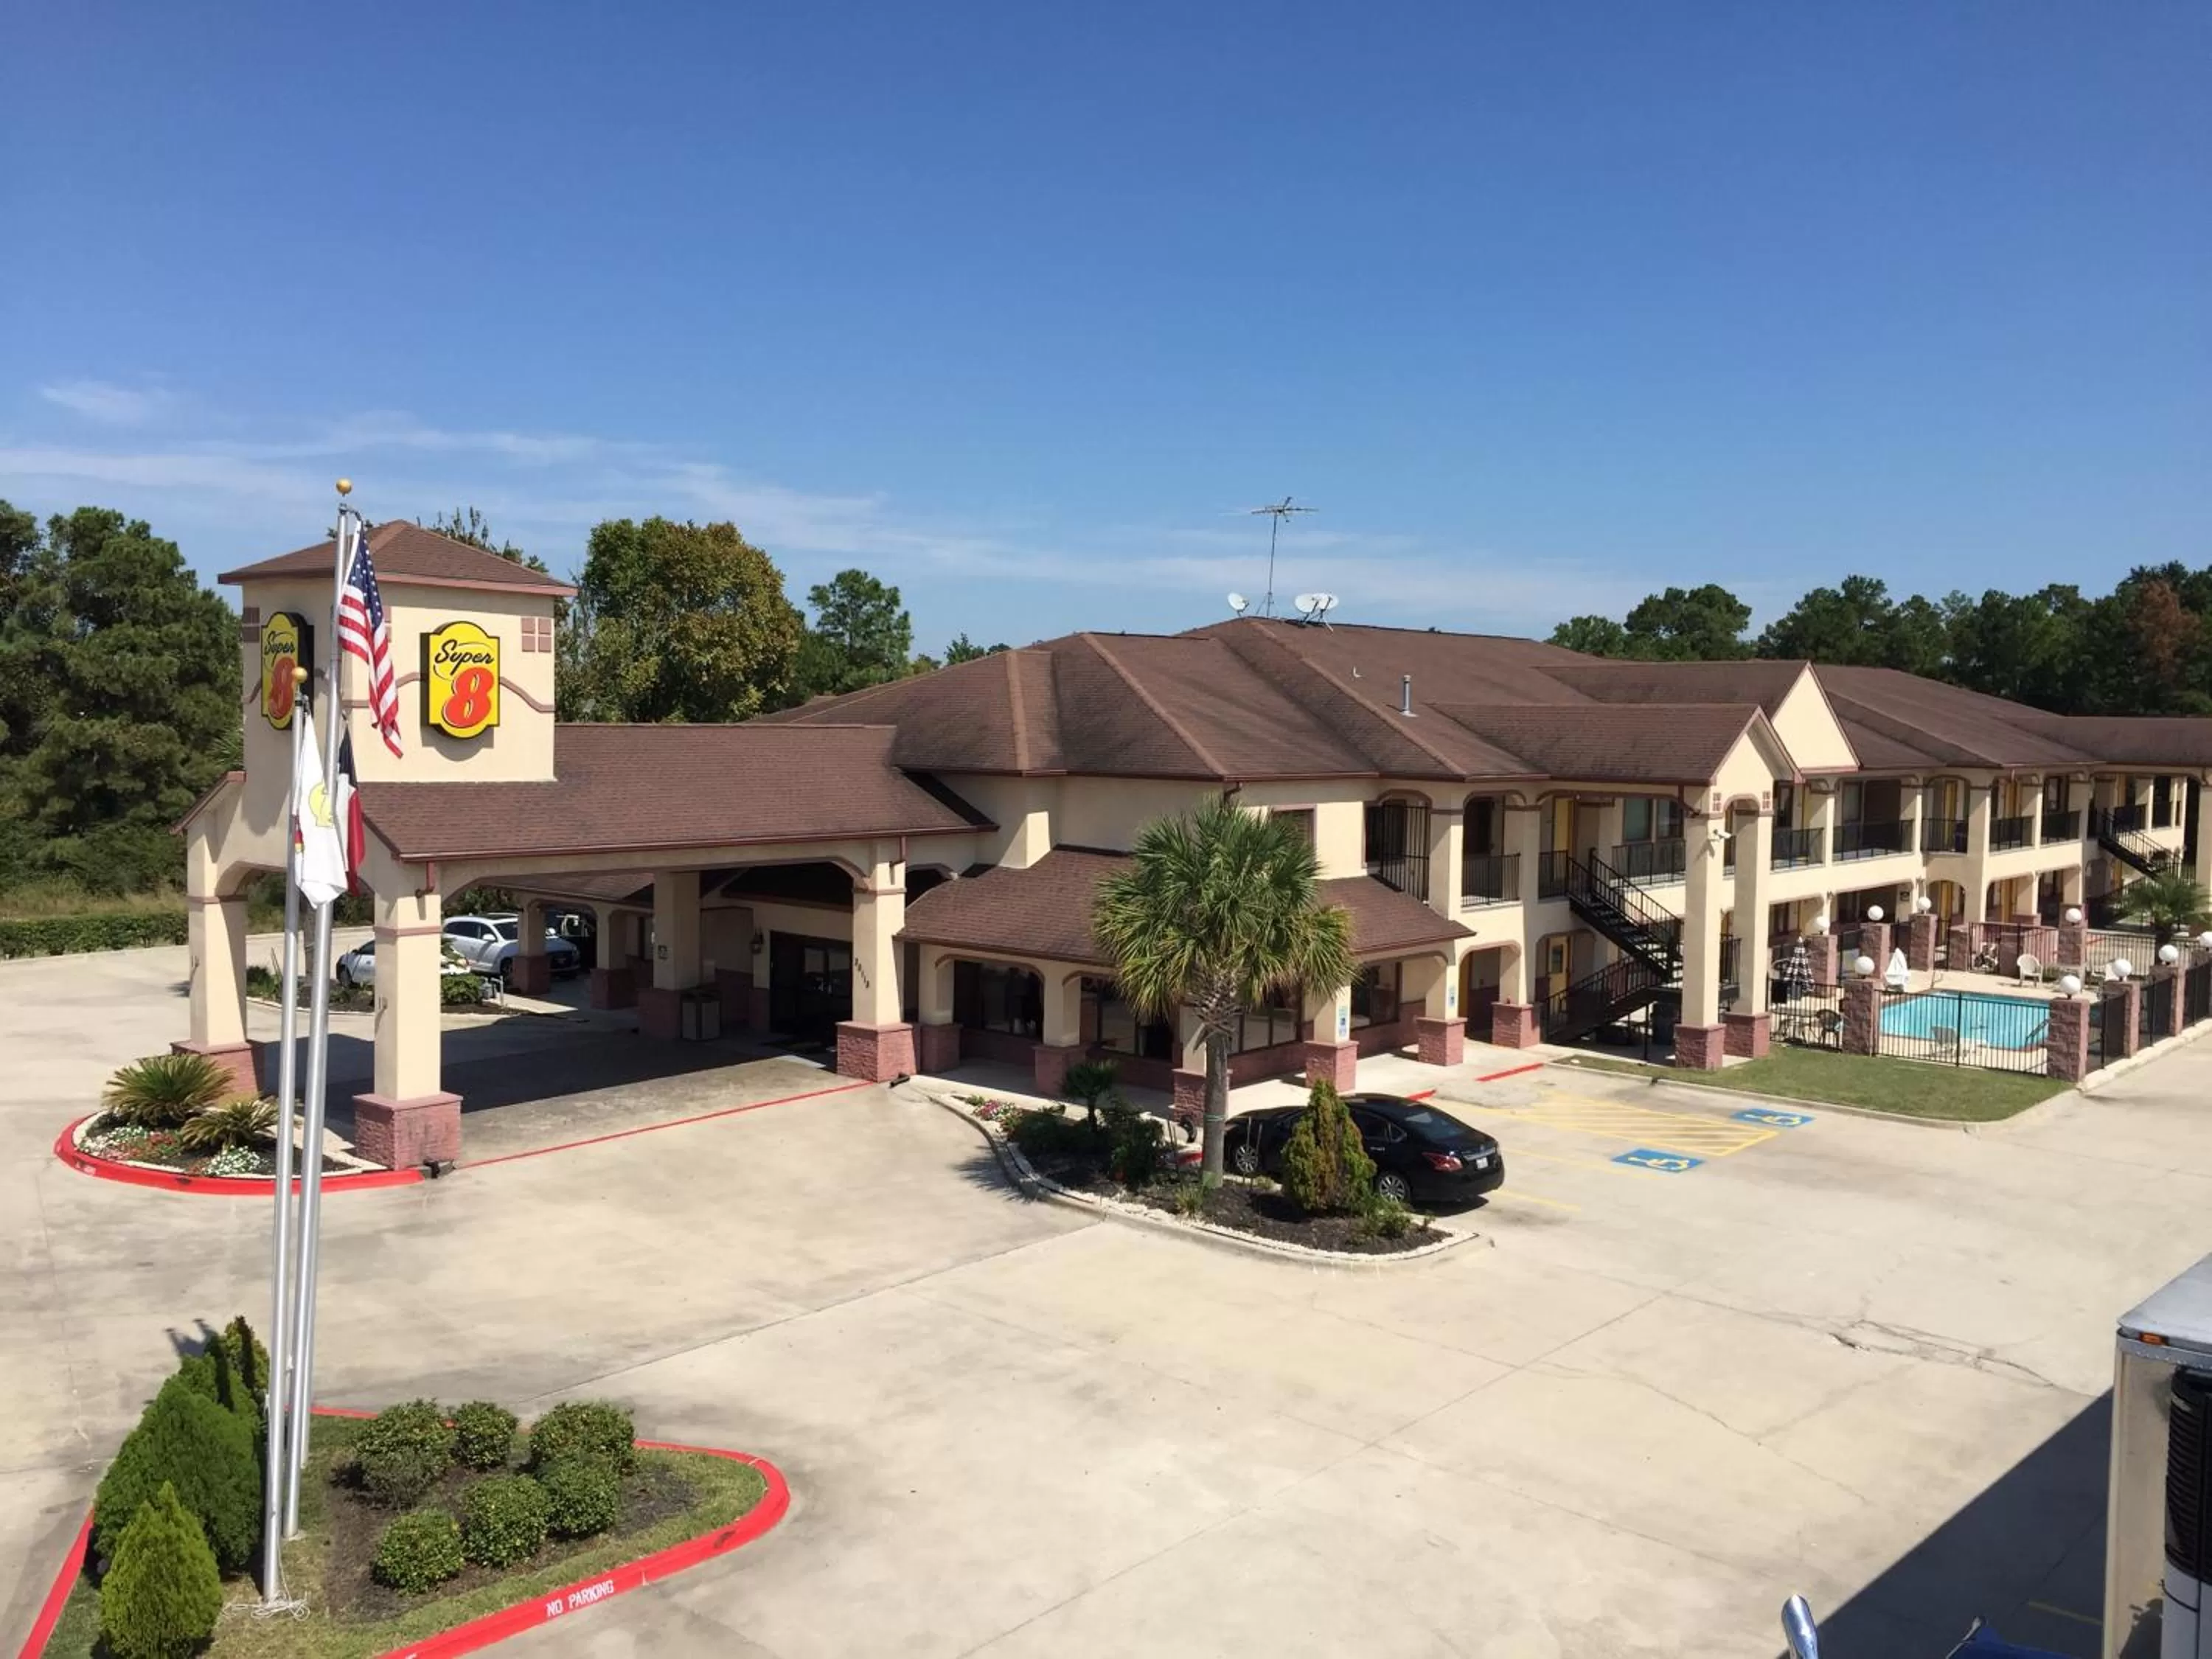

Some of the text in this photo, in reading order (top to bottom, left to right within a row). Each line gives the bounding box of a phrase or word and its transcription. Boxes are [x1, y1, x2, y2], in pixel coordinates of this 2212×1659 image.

[264, 631, 295, 667] Super
[435, 639, 494, 675] Super
[268, 657, 296, 720] 8
[441, 667, 494, 728] 8
[546, 1580, 613, 1617] NO PARKING
